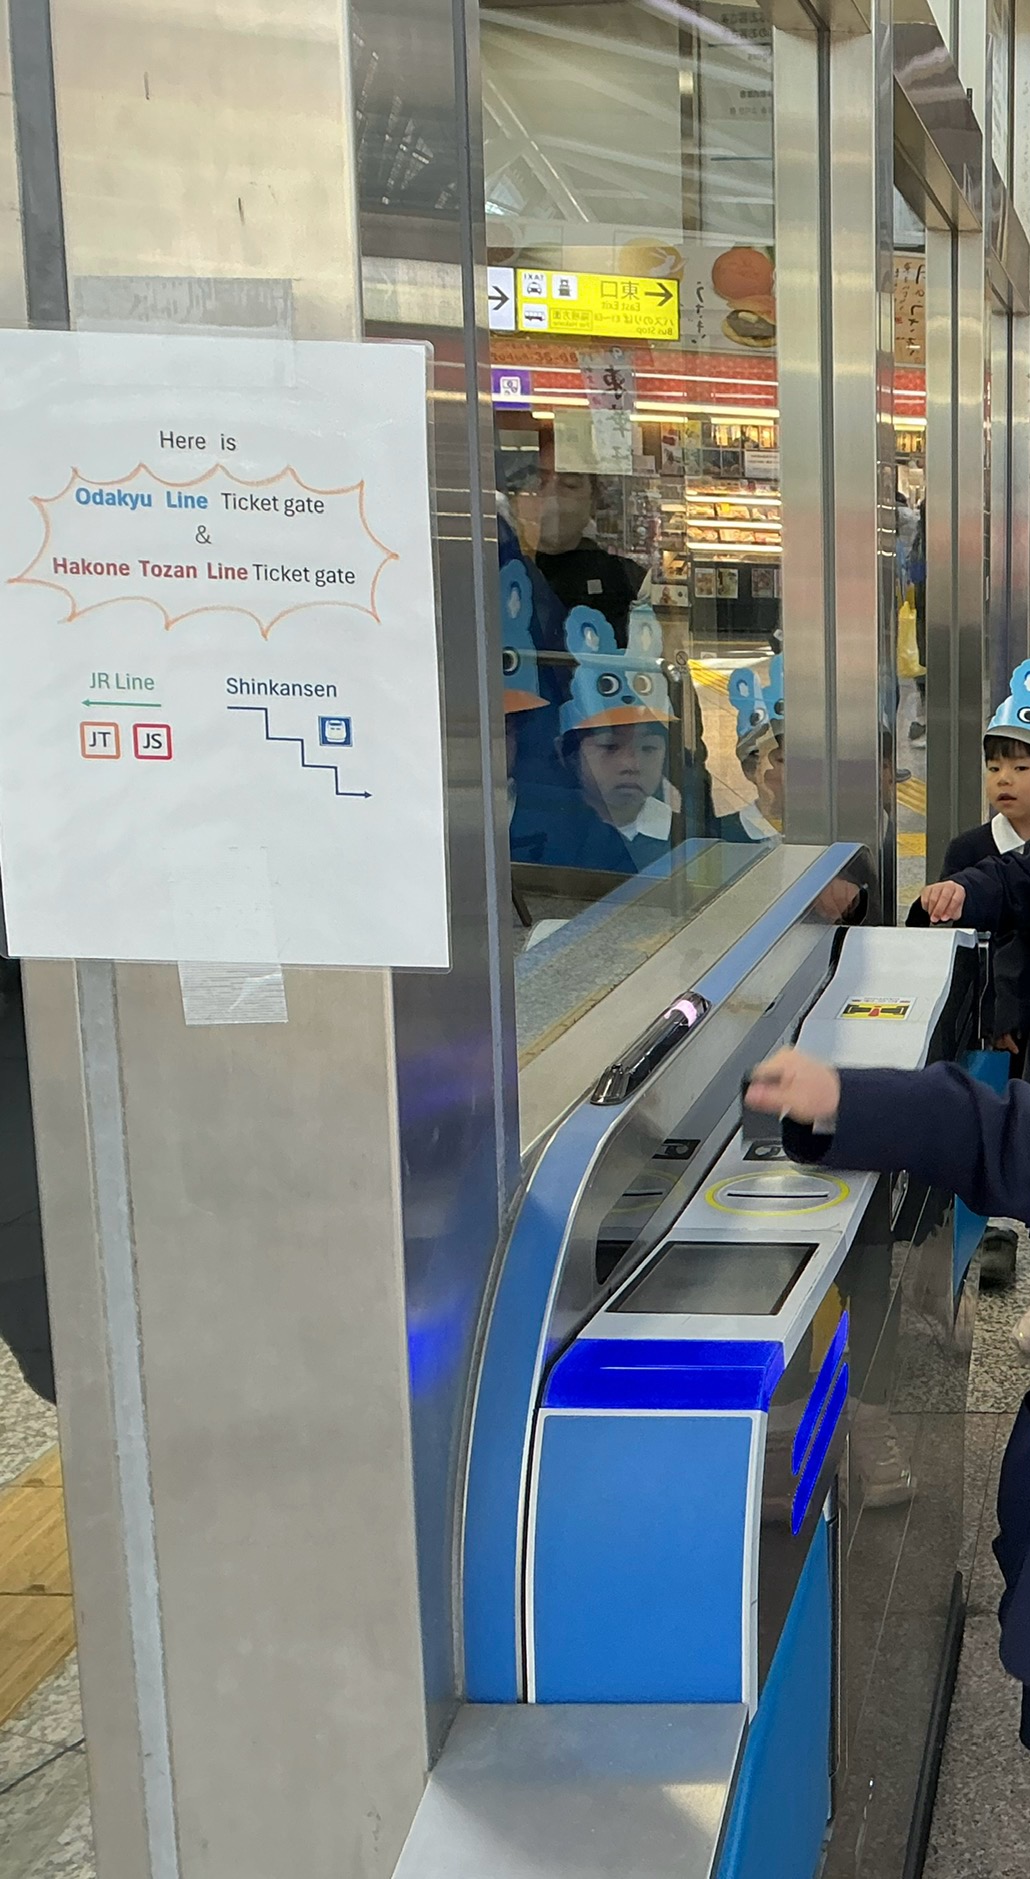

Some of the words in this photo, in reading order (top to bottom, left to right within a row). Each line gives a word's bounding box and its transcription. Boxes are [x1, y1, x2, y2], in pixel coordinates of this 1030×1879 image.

[159, 430, 206, 451] Here
[220, 433, 237, 452] is
[75, 487, 152, 511] Odakyu
[166, 490, 208, 510] Line
[221, 492, 279, 513] Ticket
[283, 496, 325, 517] gate
[195, 525, 212, 544] &
[52, 557, 130, 577] Hakone
[138, 560, 198, 579] Tozan
[207, 562, 248, 581] Line
[253, 563, 310, 584] Ticket
[314, 567, 356, 587] gate
[89, 672, 111, 691] JR
[115, 672, 155, 691] Line
[226, 677, 337, 698] Shinkansen
[88, 732, 111, 749] JT
[142, 733, 163, 750] JS
